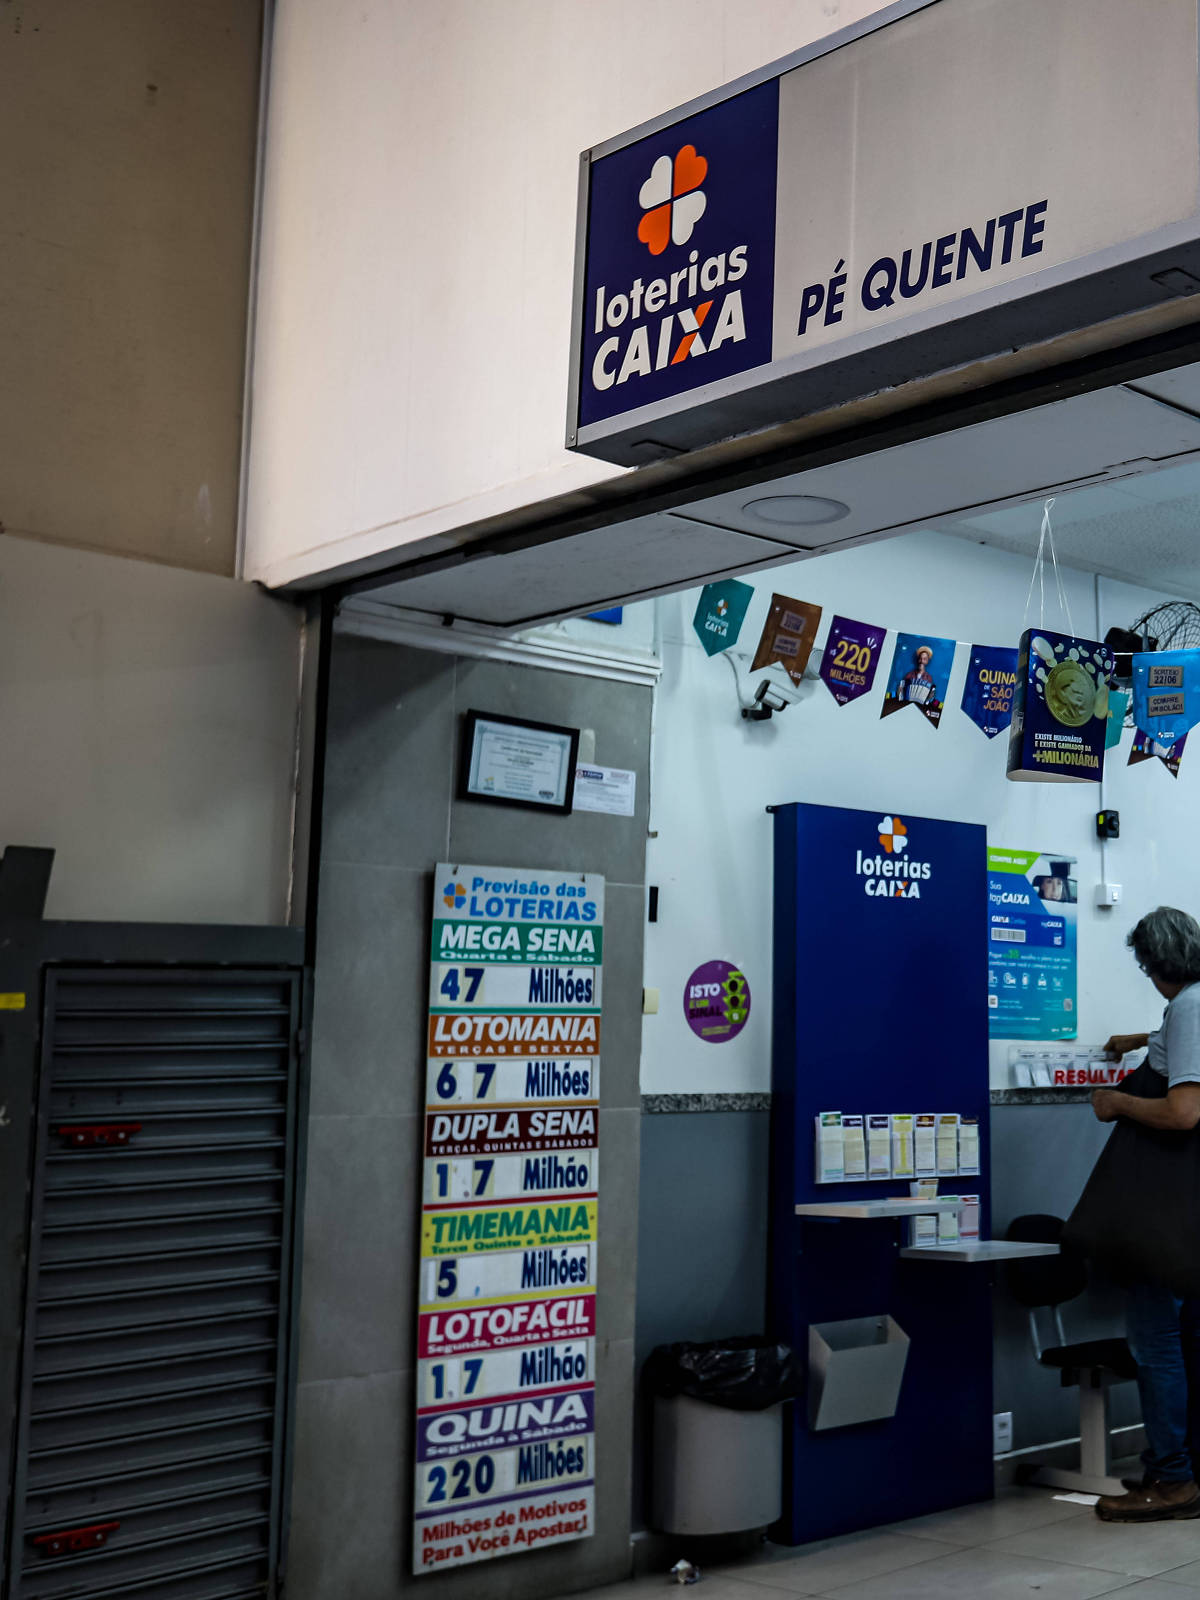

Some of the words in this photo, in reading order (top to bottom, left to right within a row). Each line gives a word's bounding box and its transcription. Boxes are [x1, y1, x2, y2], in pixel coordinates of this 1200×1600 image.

[798, 258, 847, 336] PÉ
[862, 199, 1048, 312] QUENTE
[594, 245, 748, 333] loterias
[592, 290, 746, 391] CAIXA
[833, 641, 870, 672] 220
[830, 668, 865, 685] MILHÕES
[979, 669, 1016, 685] QUINA
[984, 698, 1009, 712] JOÃO
[991, 685, 1012, 699] SÃO
[856, 850, 931, 879] loterias
[472, 877, 549, 897] Previsão
[555, 884, 586, 897] das
[865, 879, 920, 899] CAIXA
[470, 896, 597, 921] LOTERIAS
[440, 924, 521, 950] MEGA
[527, 928, 595, 952] SENA
[440, 952, 508, 960] Quarta
[441, 968, 485, 1002] 47
[528, 967, 592, 1003] Milhões
[690, 983, 720, 998] ISTO
[434, 1017, 596, 1042] LOTOMANIA
[435, 1046, 506, 1055] TERÇAS
[529, 1045, 594, 1053] SEXTAS
[525, 1062, 589, 1098] Milhões
[431, 1114, 520, 1142] DUPLA
[528, 1110, 595, 1138] SENA
[484, 1142, 532, 1151] QUINTAS
[523, 1156, 588, 1190] Milhão
[432, 1206, 589, 1242] TIMEMANIA
[438, 1260, 457, 1297] 5
[521, 1249, 586, 1289] Milhões
[428, 1299, 589, 1343] LOTOFÁCIL
[494, 1332, 539, 1345] Quarta
[552, 1327, 588, 1337] Sexta
[520, 1346, 585, 1386] Milhão
[426, 1394, 587, 1443] QUINA
[427, 1437, 505, 1456] Segunda
[427, 1455, 495, 1503] 220
[517, 1442, 584, 1486] Milhões
[423, 1518, 491, 1543] Milhões
[495, 1510, 515, 1528] de
[520, 1499, 587, 1523] Motivos
[423, 1545, 464, 1564] Para
[468, 1530, 510, 1553] Você
[514, 1515, 587, 1545] Apostar!
